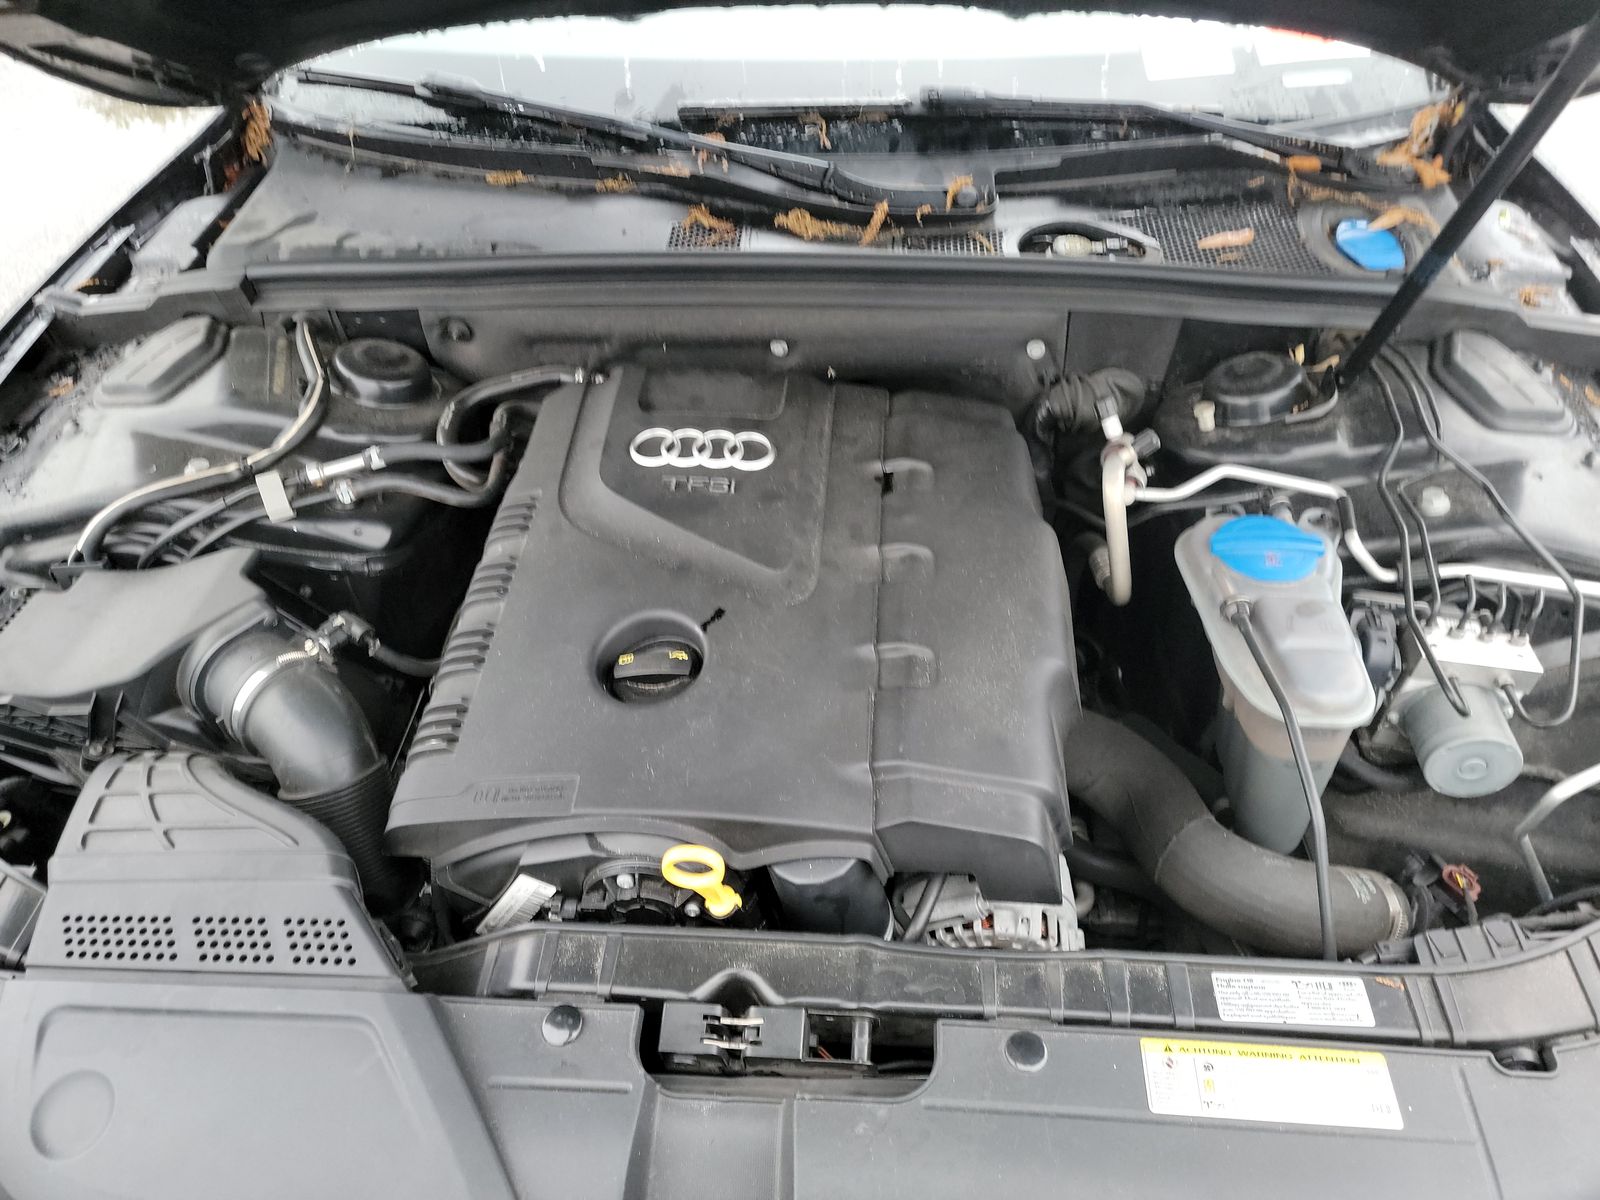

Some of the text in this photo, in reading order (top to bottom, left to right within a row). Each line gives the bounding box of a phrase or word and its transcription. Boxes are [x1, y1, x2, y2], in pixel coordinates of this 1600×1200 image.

[661, 475, 736, 495] TFSI
[1179, 1046, 1361, 1064] ACHTUNG WARNING ATTENTION
